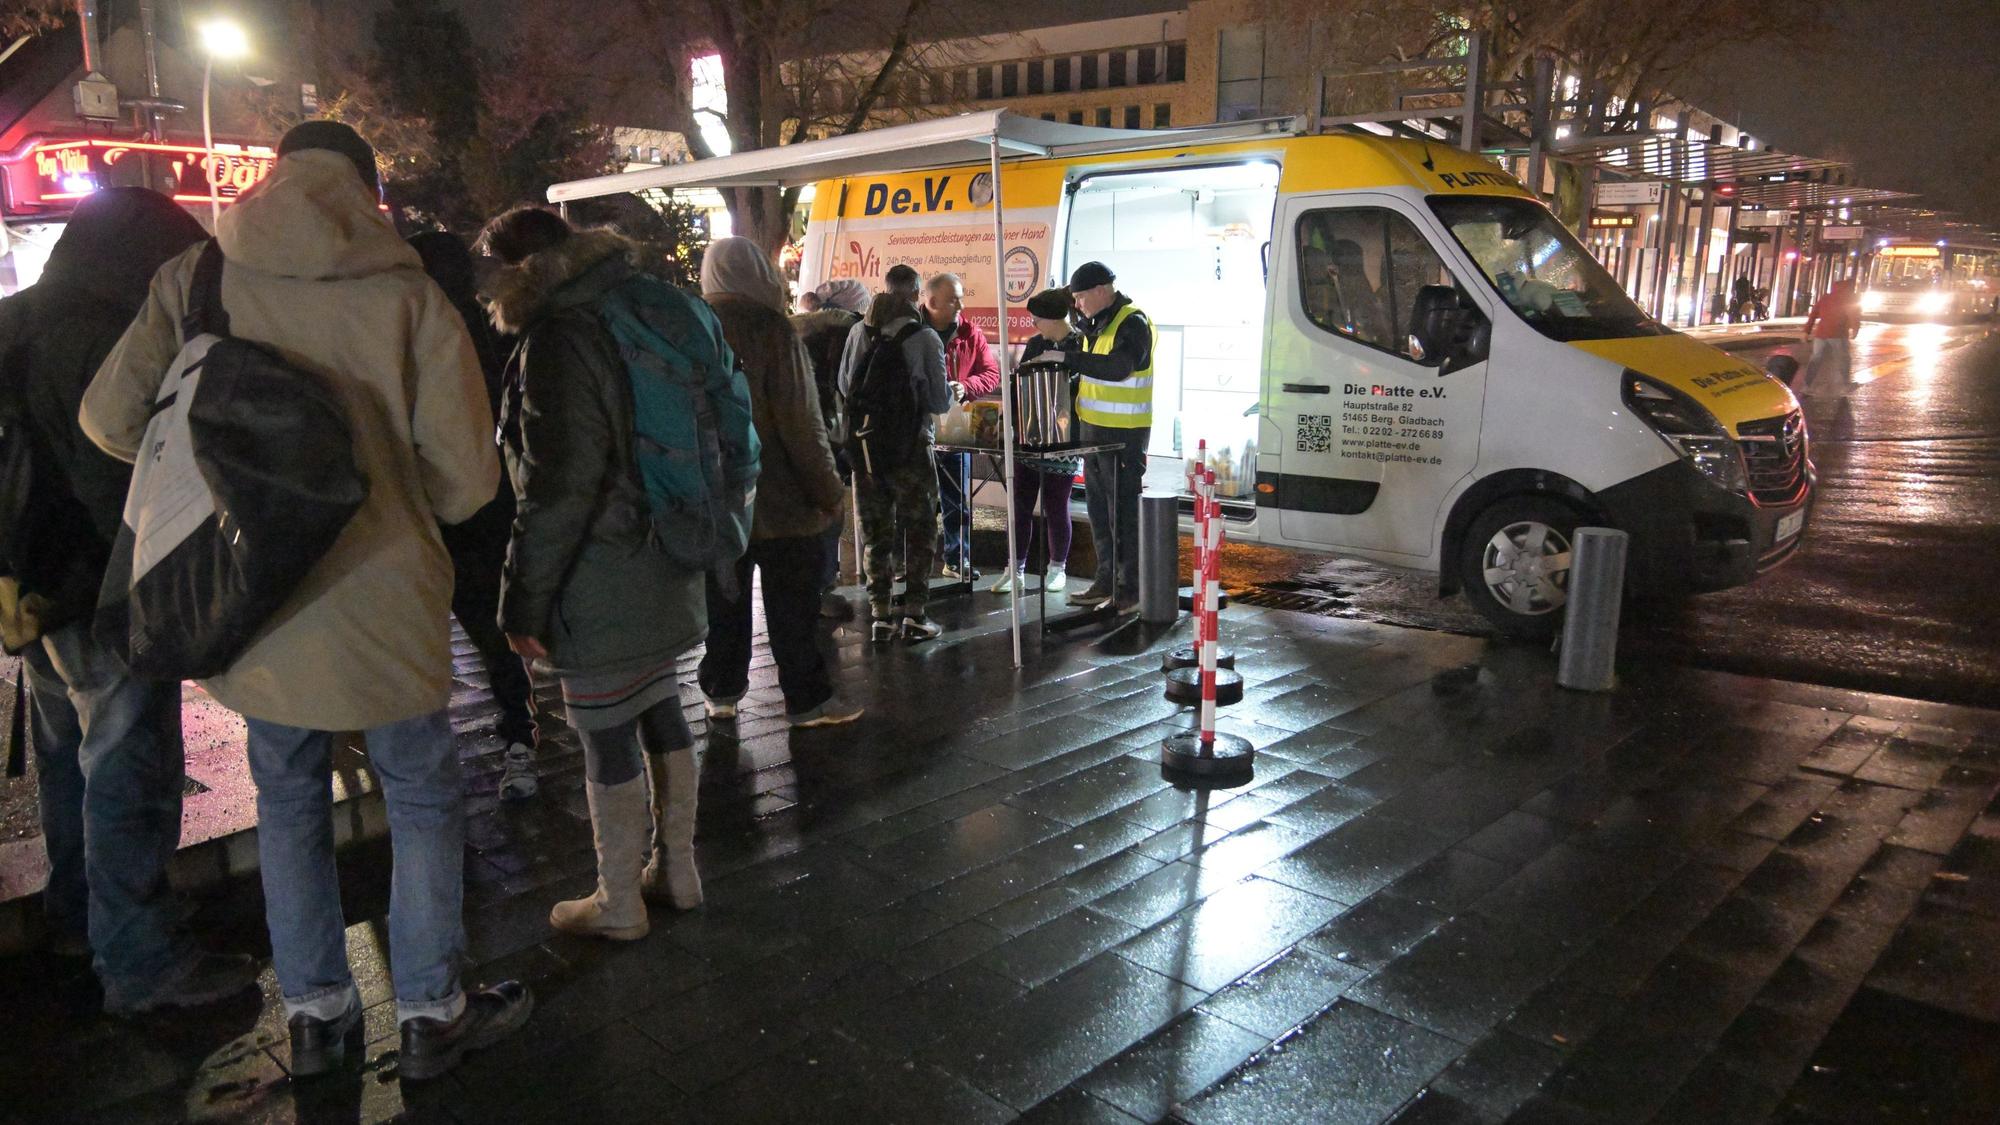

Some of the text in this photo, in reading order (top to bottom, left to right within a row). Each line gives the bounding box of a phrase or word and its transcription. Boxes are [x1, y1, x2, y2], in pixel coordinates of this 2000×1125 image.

[1649, 187, 1659, 197] 14
[888, 230, 981, 246] Seniorendienstleistungen
[1020, 226, 1046, 240] Hand
[831, 241, 880, 278] SenVit
[901, 256, 922, 266] Pflege
[928, 255, 992, 266] Alltagsbegleitung
[1344, 383, 1446, 399] Die Platte e.V.
[1343, 401, 1413, 412] Hauptstraße 82
[1342, 413, 1444, 427] 51465 Berg. Gladbach
[1342, 425, 1360, 435] Tel.:
[1342, 439, 1421, 451] www.platte-ev.de
[1341, 450, 1442, 465] kontakt@platte-ev.de
